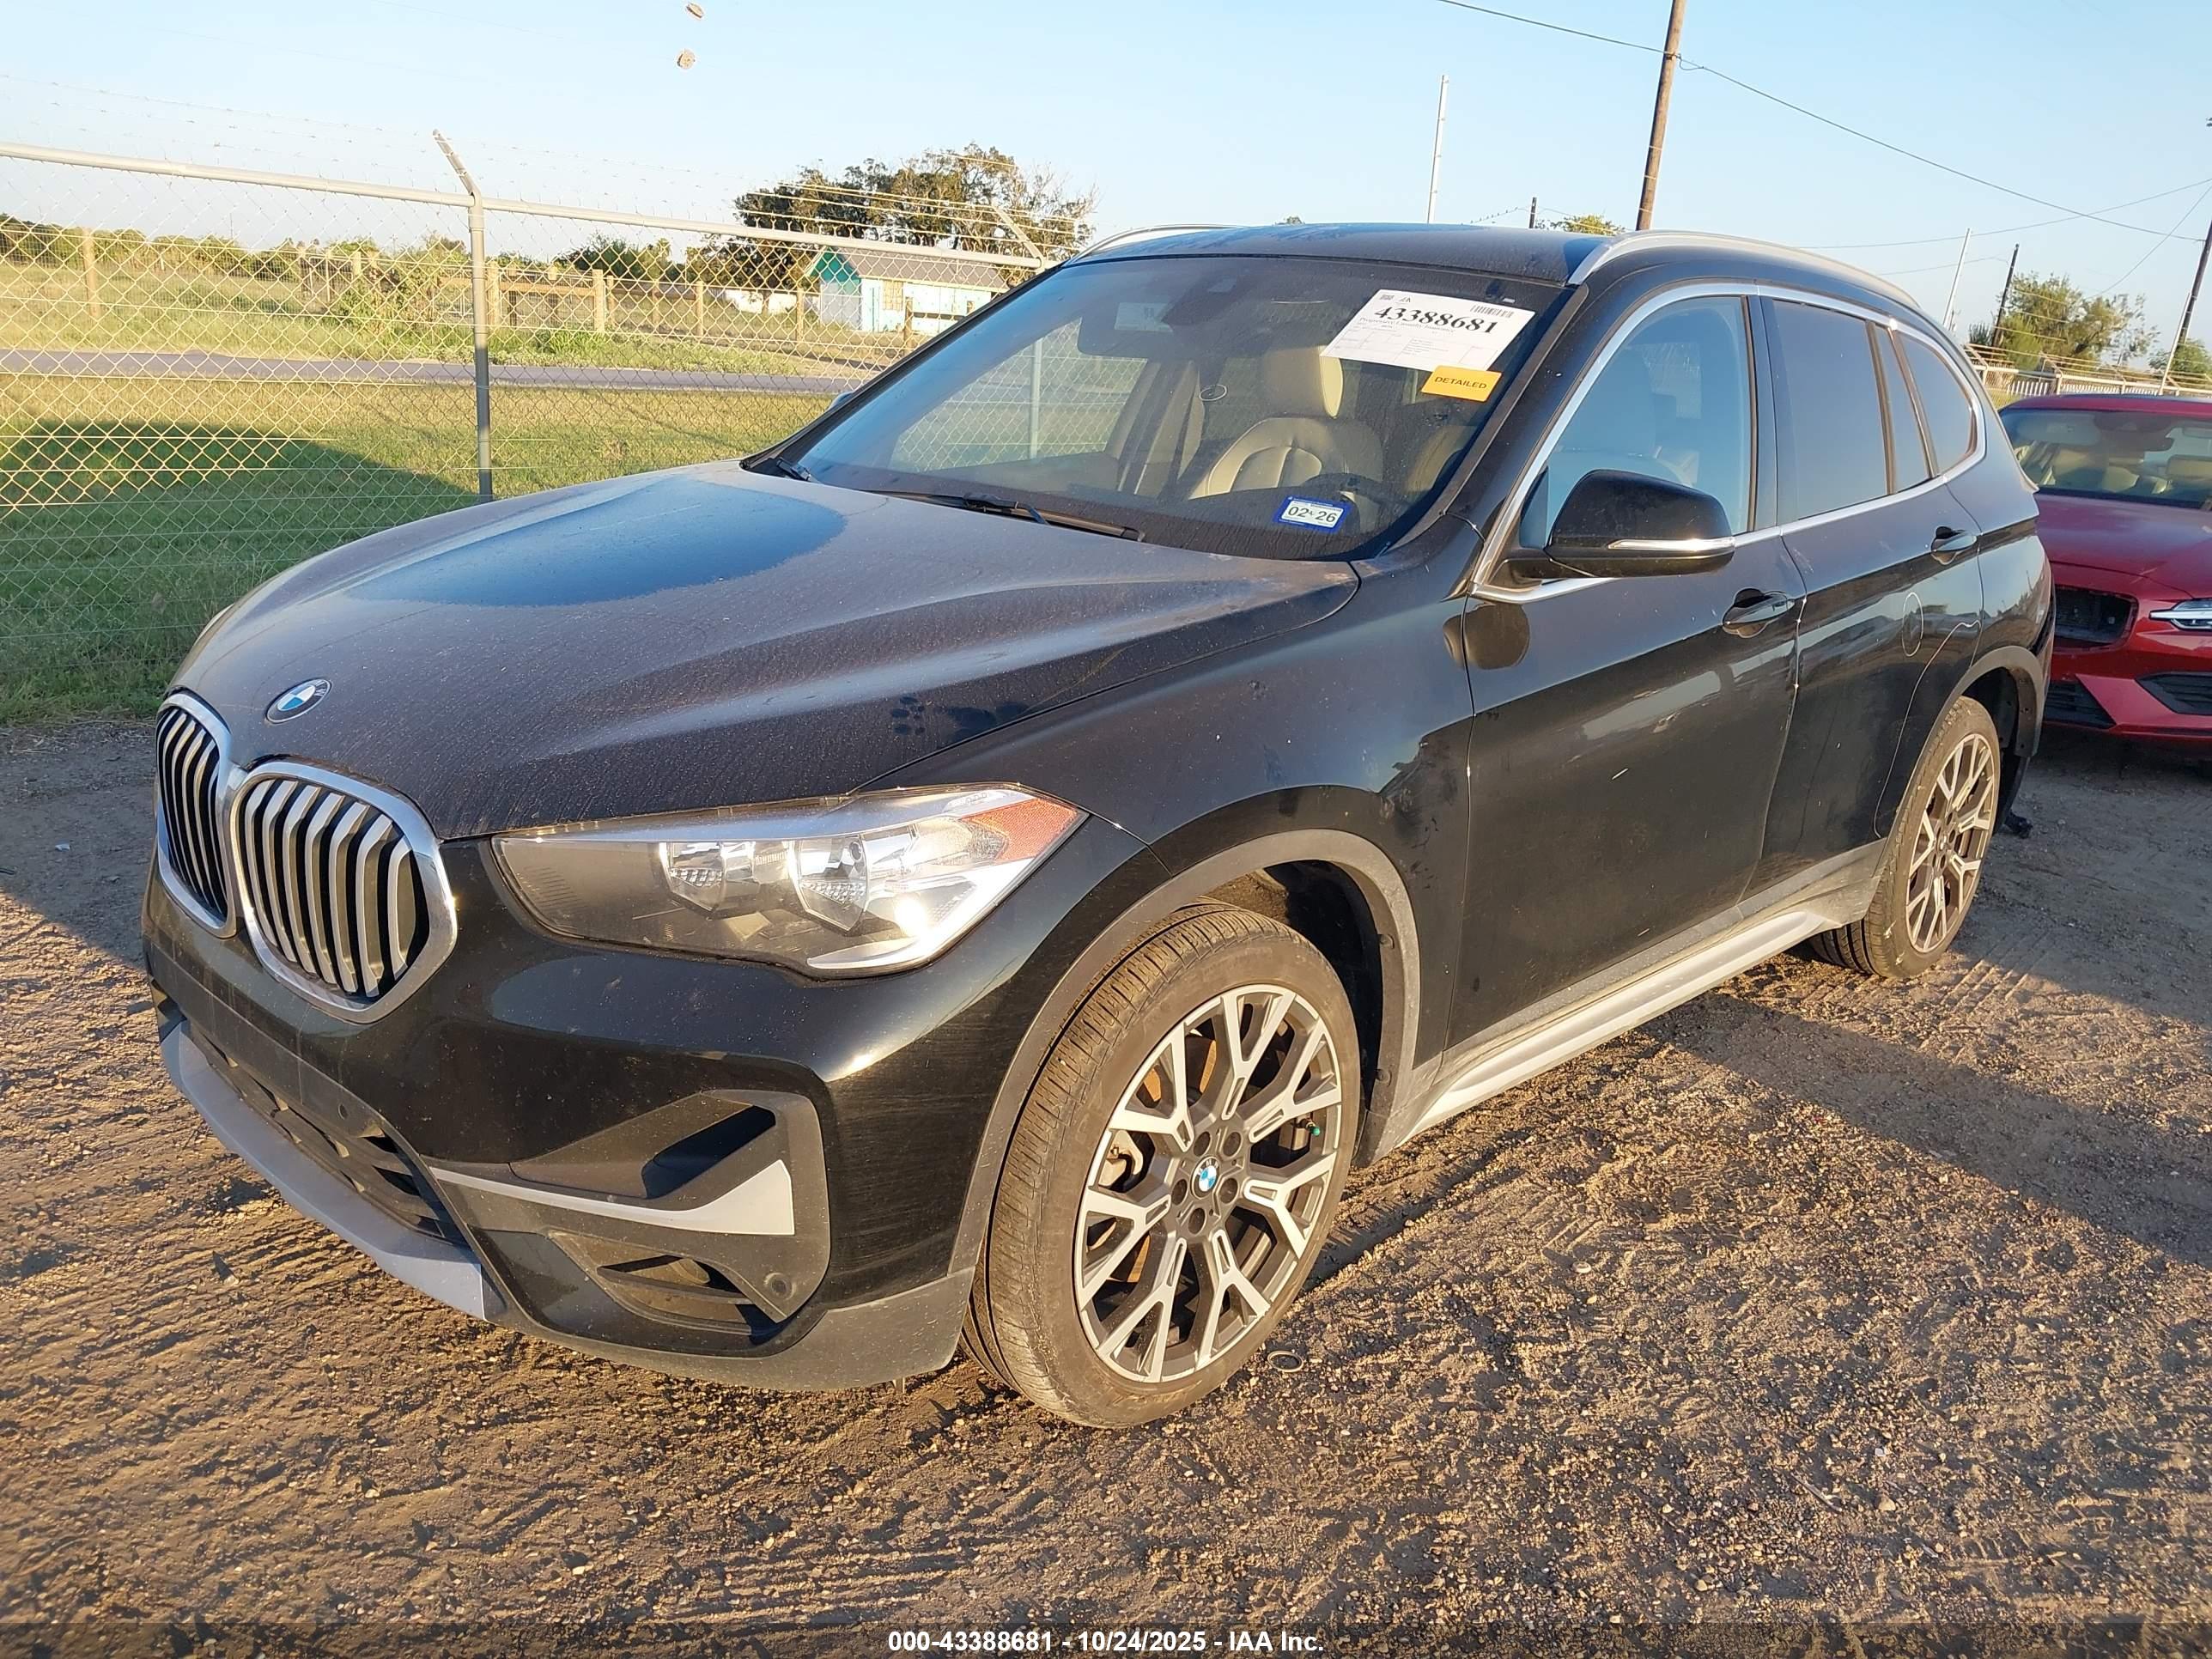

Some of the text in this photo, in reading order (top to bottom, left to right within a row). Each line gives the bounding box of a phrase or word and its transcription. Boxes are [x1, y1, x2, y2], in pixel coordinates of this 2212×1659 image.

[1374, 307, 1498, 333] 43388681
[1434, 376, 1487, 389] DETAILED
[1288, 507, 1309, 517] 02
[1315, 511, 1337, 522] 26
